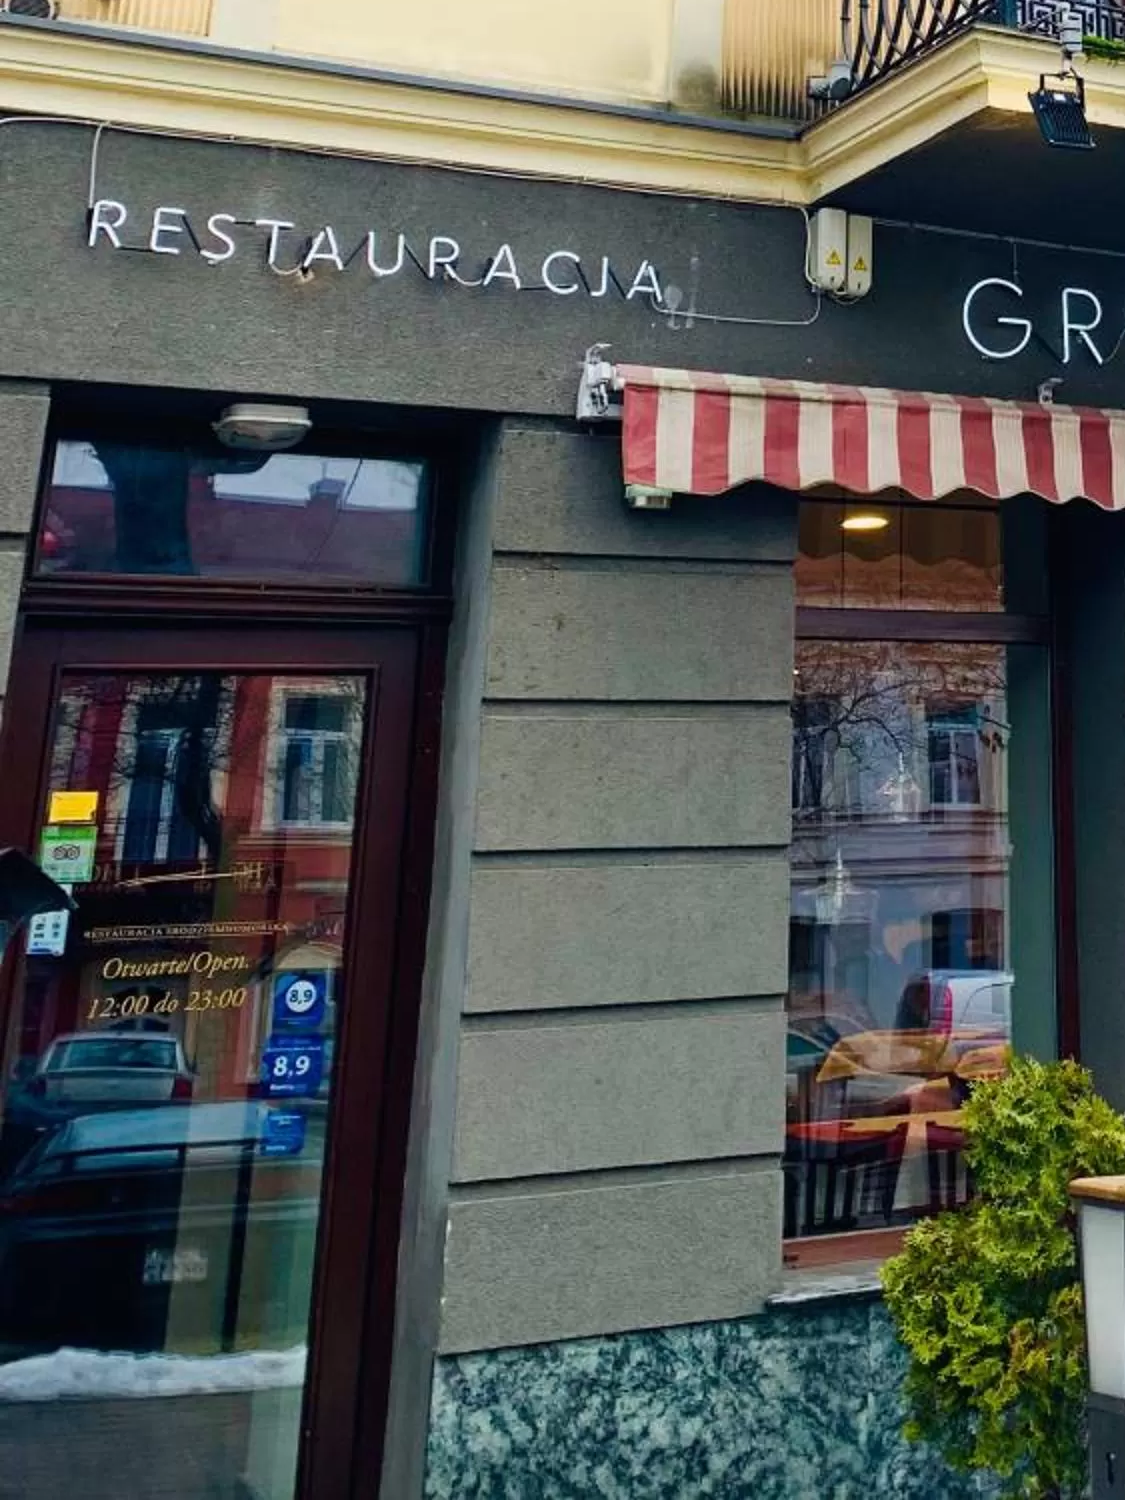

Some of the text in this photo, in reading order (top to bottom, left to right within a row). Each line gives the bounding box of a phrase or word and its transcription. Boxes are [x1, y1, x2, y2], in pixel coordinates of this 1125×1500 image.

[88, 199, 664, 303] RESTAURACJA
[87, 986, 248, 1020] 12:00 do 23:00
[272, 1054, 311, 1080] 8,9
